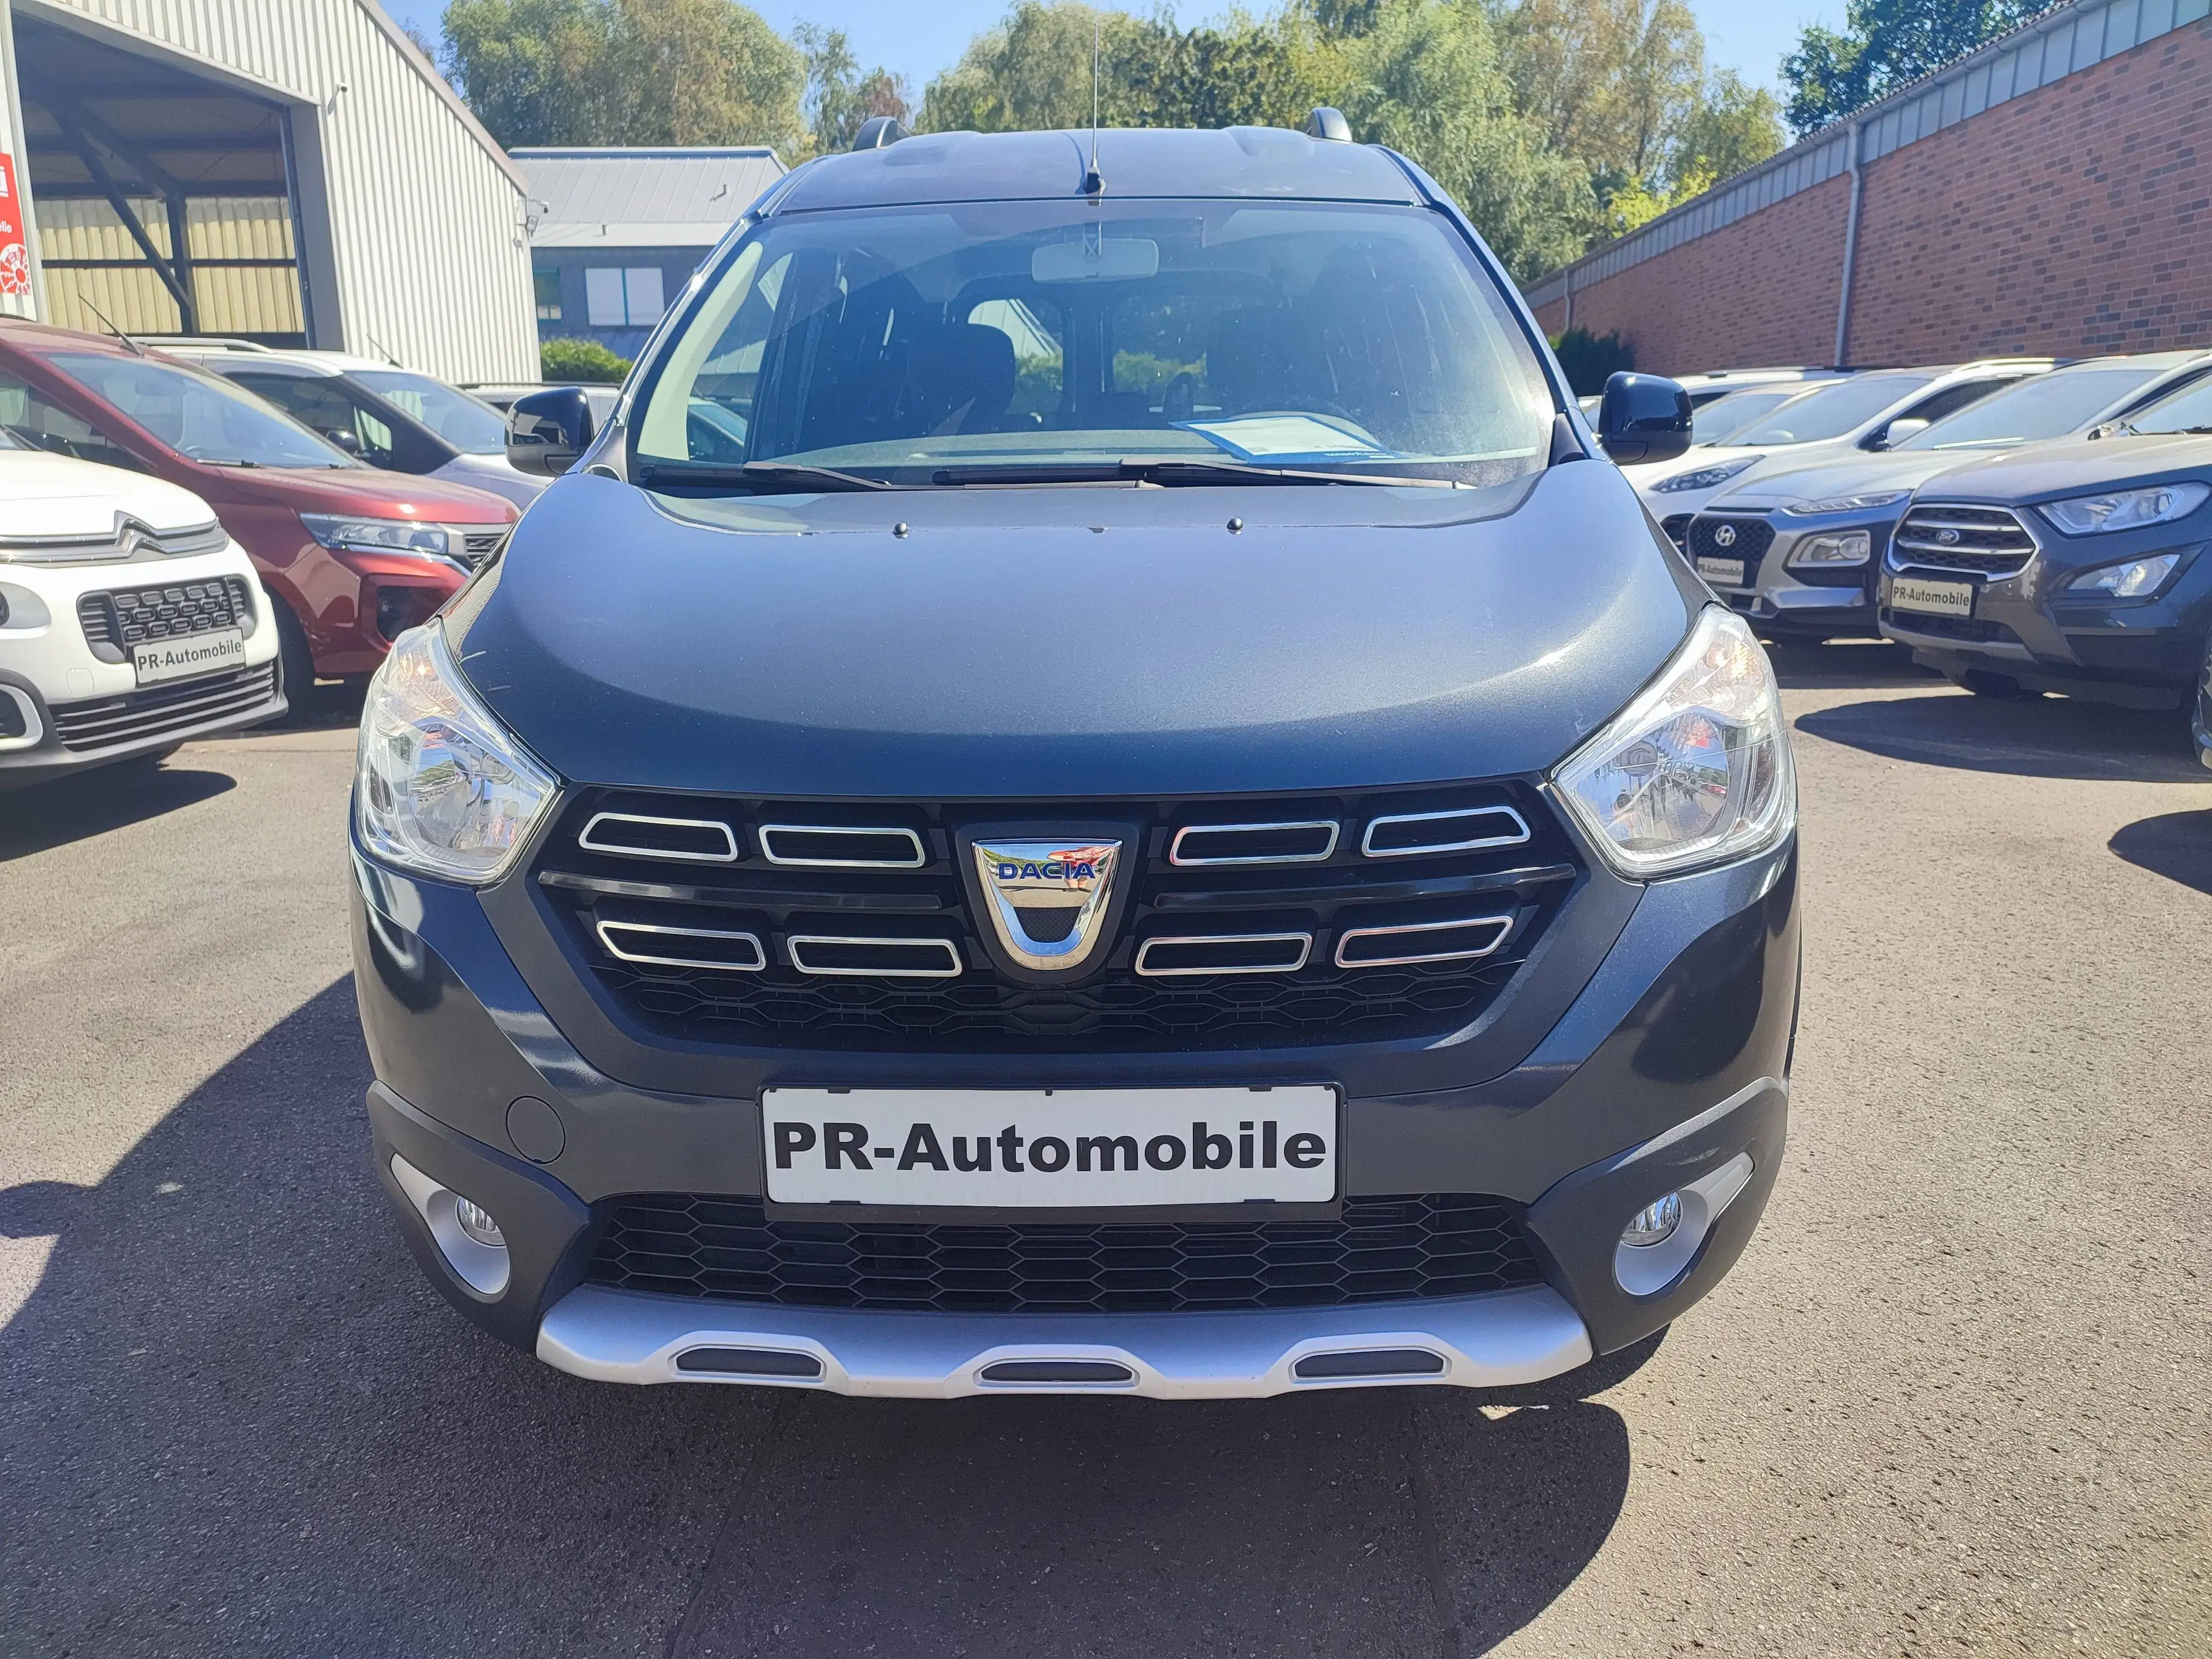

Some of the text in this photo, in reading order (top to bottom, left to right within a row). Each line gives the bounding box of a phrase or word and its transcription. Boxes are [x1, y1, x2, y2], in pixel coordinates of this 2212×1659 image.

[1893, 586, 1969, 607] PR-Automobile
[138, 639, 242, 671] PR-Automobile
[998, 862, 1096, 880] DACIA
[773, 1121, 1326, 1172] PR-Automobile
